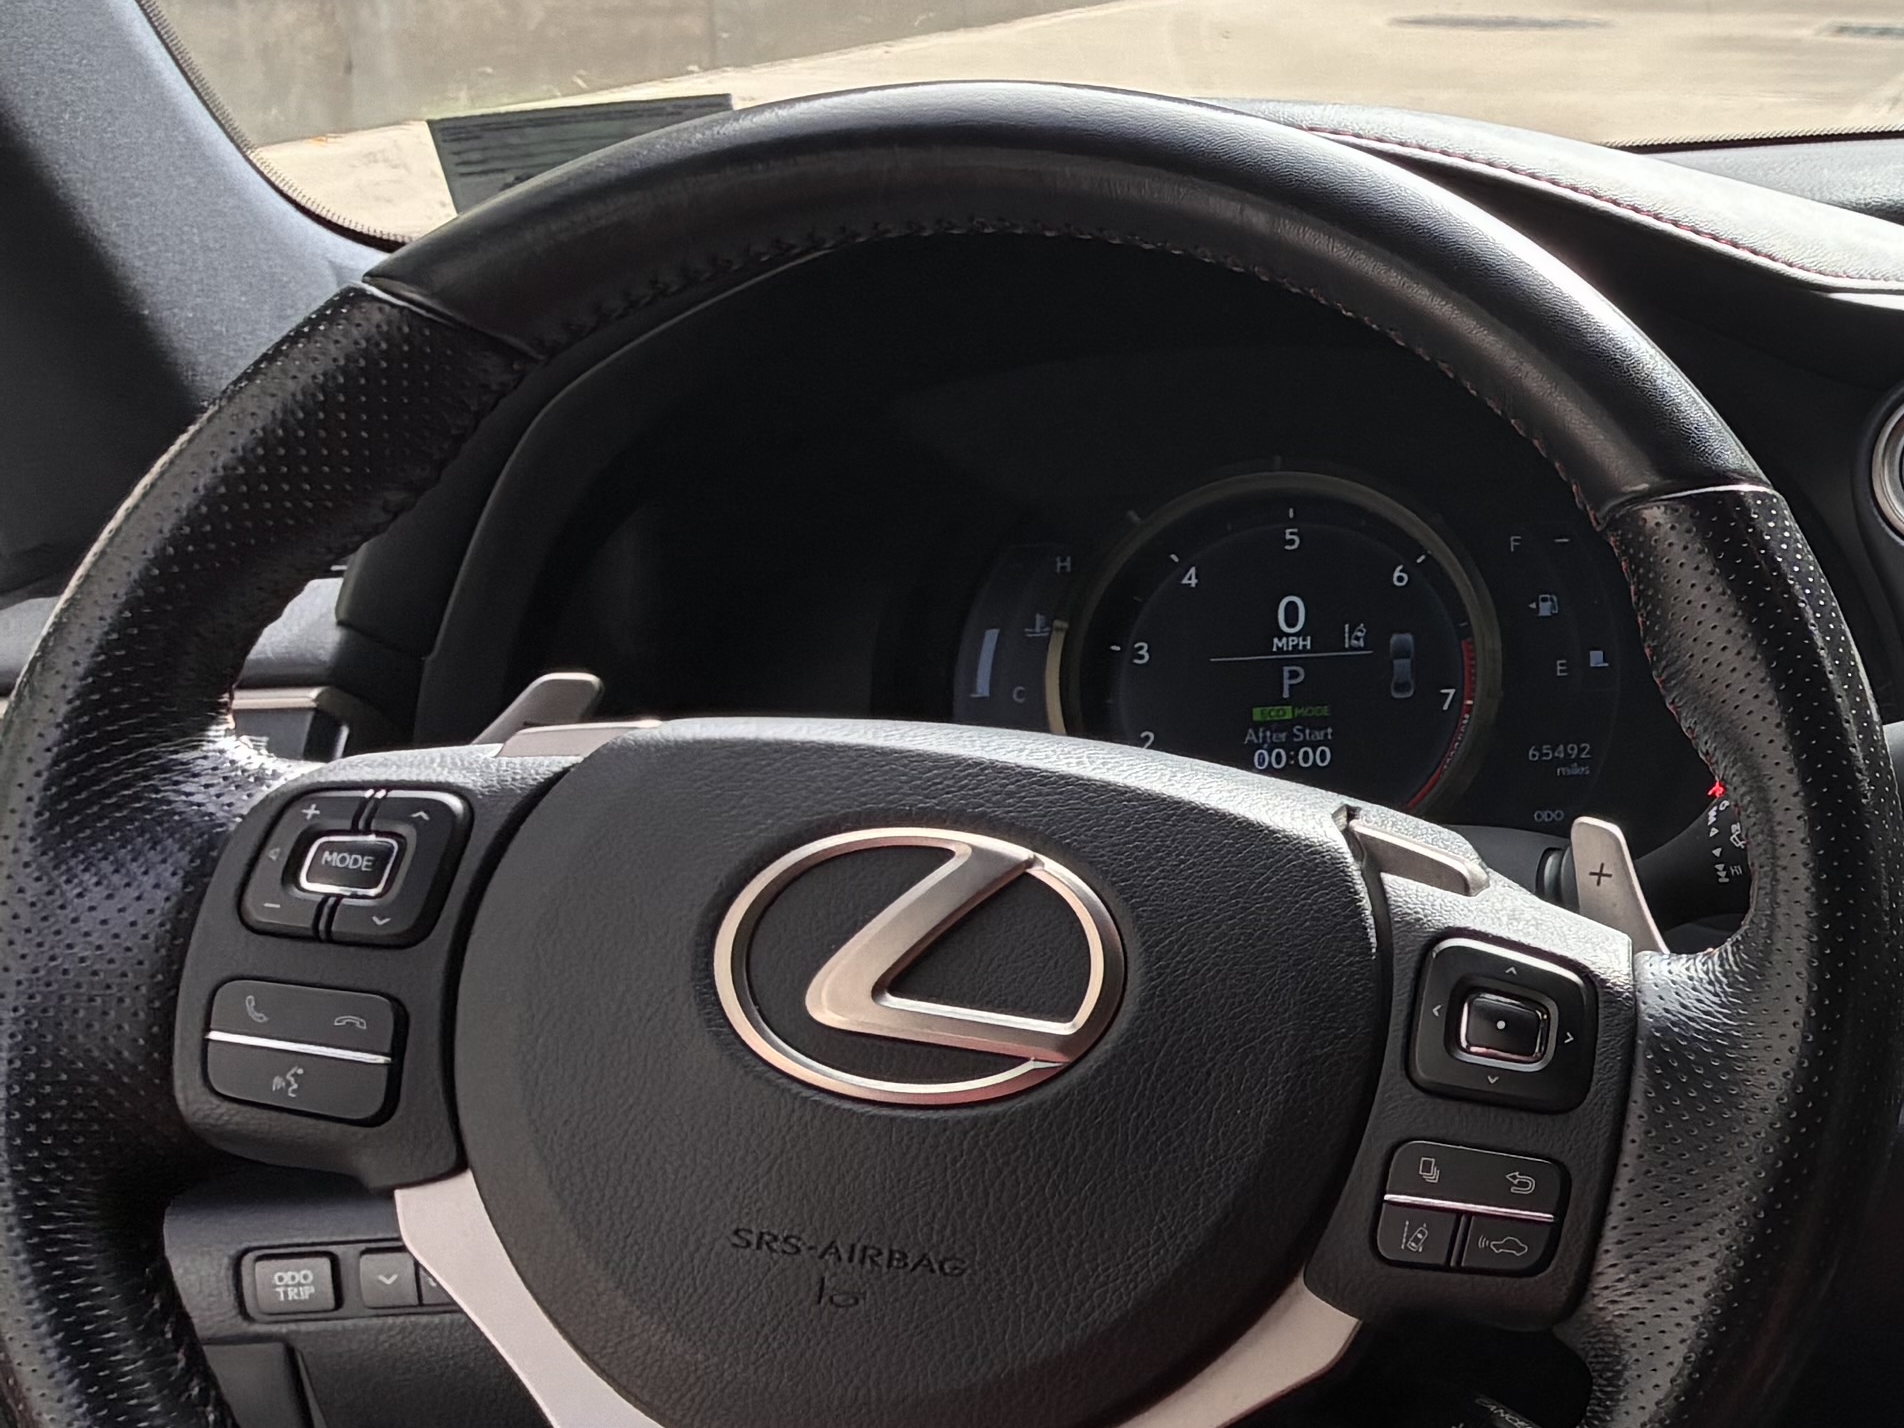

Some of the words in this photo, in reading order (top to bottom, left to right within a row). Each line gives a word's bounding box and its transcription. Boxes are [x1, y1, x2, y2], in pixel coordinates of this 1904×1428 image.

[1284, 527, 1300, 550] 5
[1510, 536, 1522, 553] F
[1056, 556, 1072, 573] H
[1181, 566, 1199, 588] 4
[1392, 565, 1409, 587] 6
[1277, 595, 1306, 634] 0
[1132, 641, 1150, 664] 3
[1272, 635, 1311, 652] MPH
[1556, 660, 1569, 677] E
[1281, 665, 1305, 699] P
[1012, 685, 1026, 703] C
[1439, 688, 1456, 711] 7
[1259, 707, 1287, 719] ECO
[1295, 705, 1331, 718] MODE
[1244, 726, 1287, 745] After
[1293, 725, 1333, 742] Start
[1254, 745, 1331, 770] 00:00
[1528, 743, 1592, 761] 65492
[1534, 810, 1564, 822] ODO
[321, 849, 375, 873] MODE
[729, 1226, 969, 1279] SRS-AIRBAG
[273, 1269, 314, 1286] ODO
[274, 1286, 316, 1302] TRIP
